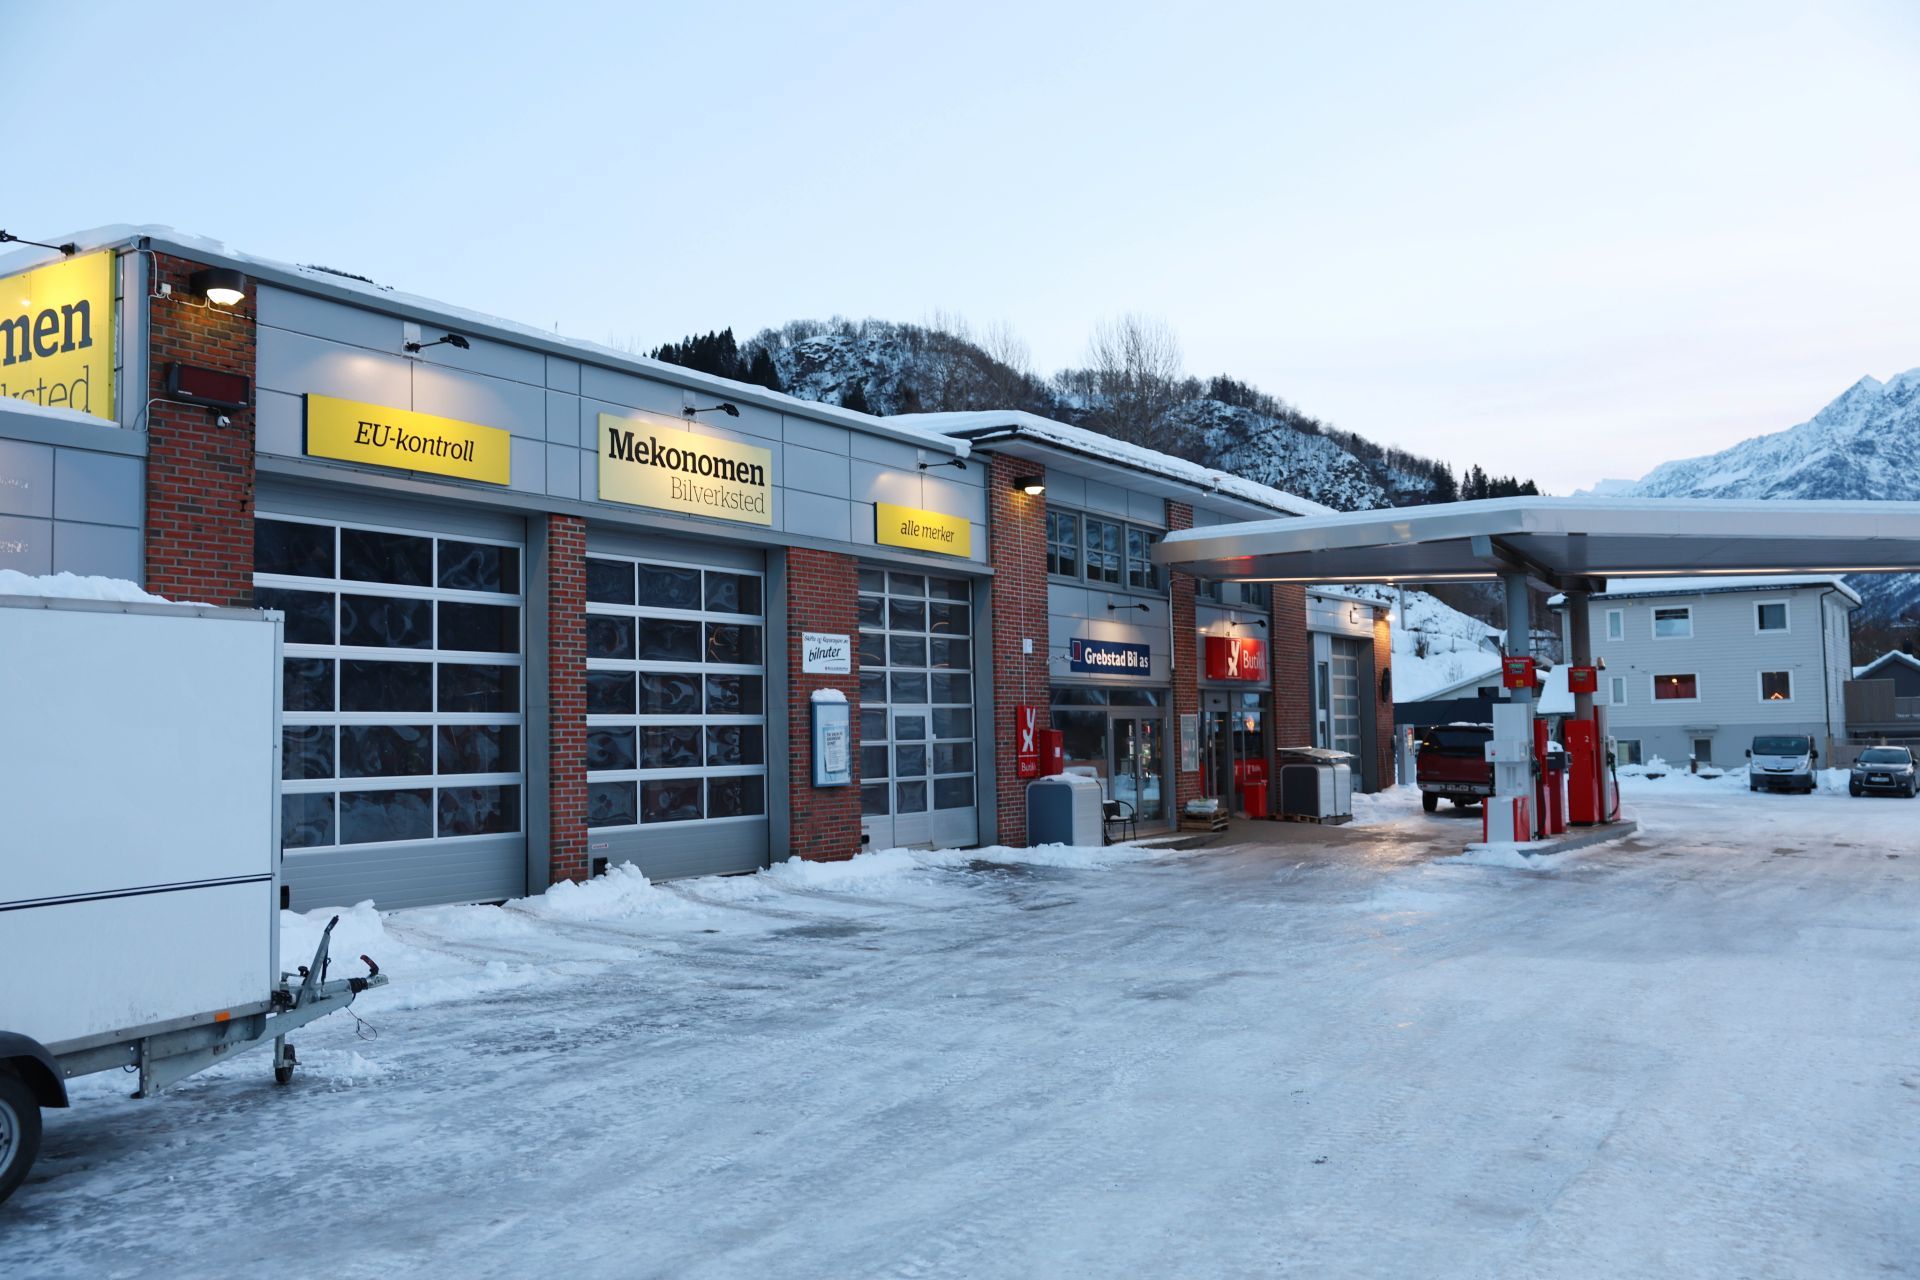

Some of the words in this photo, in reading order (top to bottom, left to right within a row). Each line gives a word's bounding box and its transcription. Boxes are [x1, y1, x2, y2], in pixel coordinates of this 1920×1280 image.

[354, 421, 475, 462] EU-kontroll
[608, 427, 765, 487] Mekonomen
[671, 476, 765, 514] Bilverksted
[900, 520, 920, 537] alle
[922, 525, 955, 543] merker
[808, 645, 841, 662] bilruter
[1084, 647, 1126, 667] Grebstad
[1127, 650, 1138, 667] Bil
[1139, 656, 1149, 668] as
